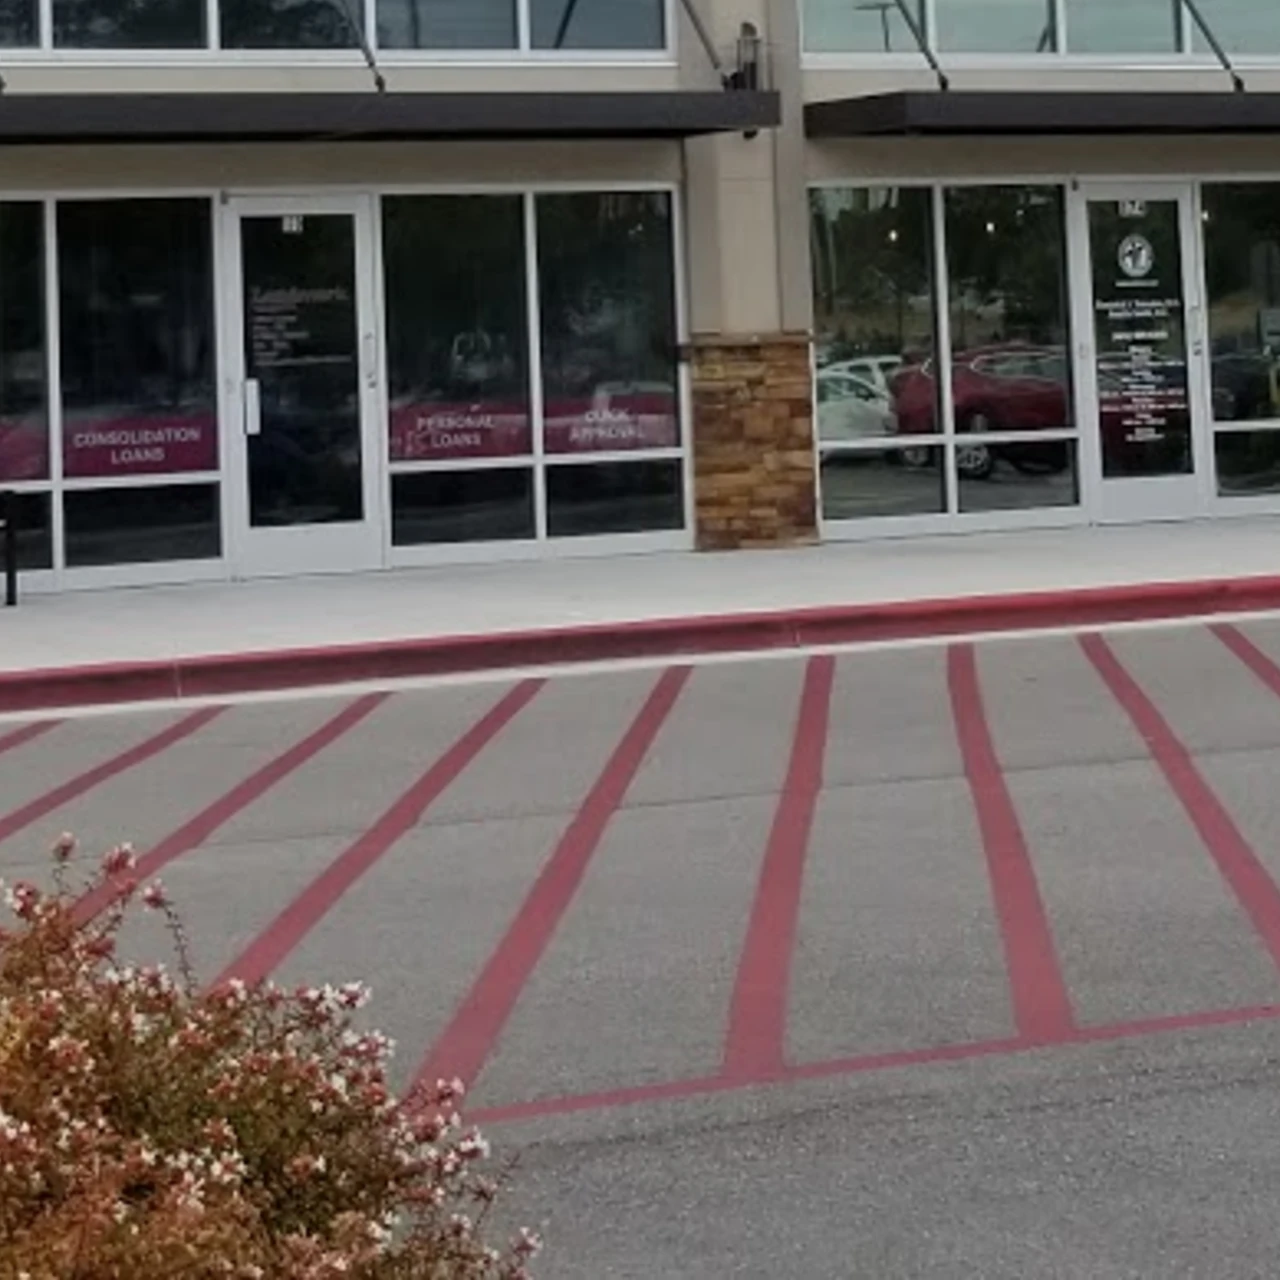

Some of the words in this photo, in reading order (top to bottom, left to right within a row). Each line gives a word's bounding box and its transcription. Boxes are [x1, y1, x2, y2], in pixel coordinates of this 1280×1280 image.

[416, 414, 495, 431] PERSONAL
[73, 426, 202, 448] CONSOLIDATION
[430, 432, 482, 449] LOANS
[110, 447, 166, 465] LOANS
